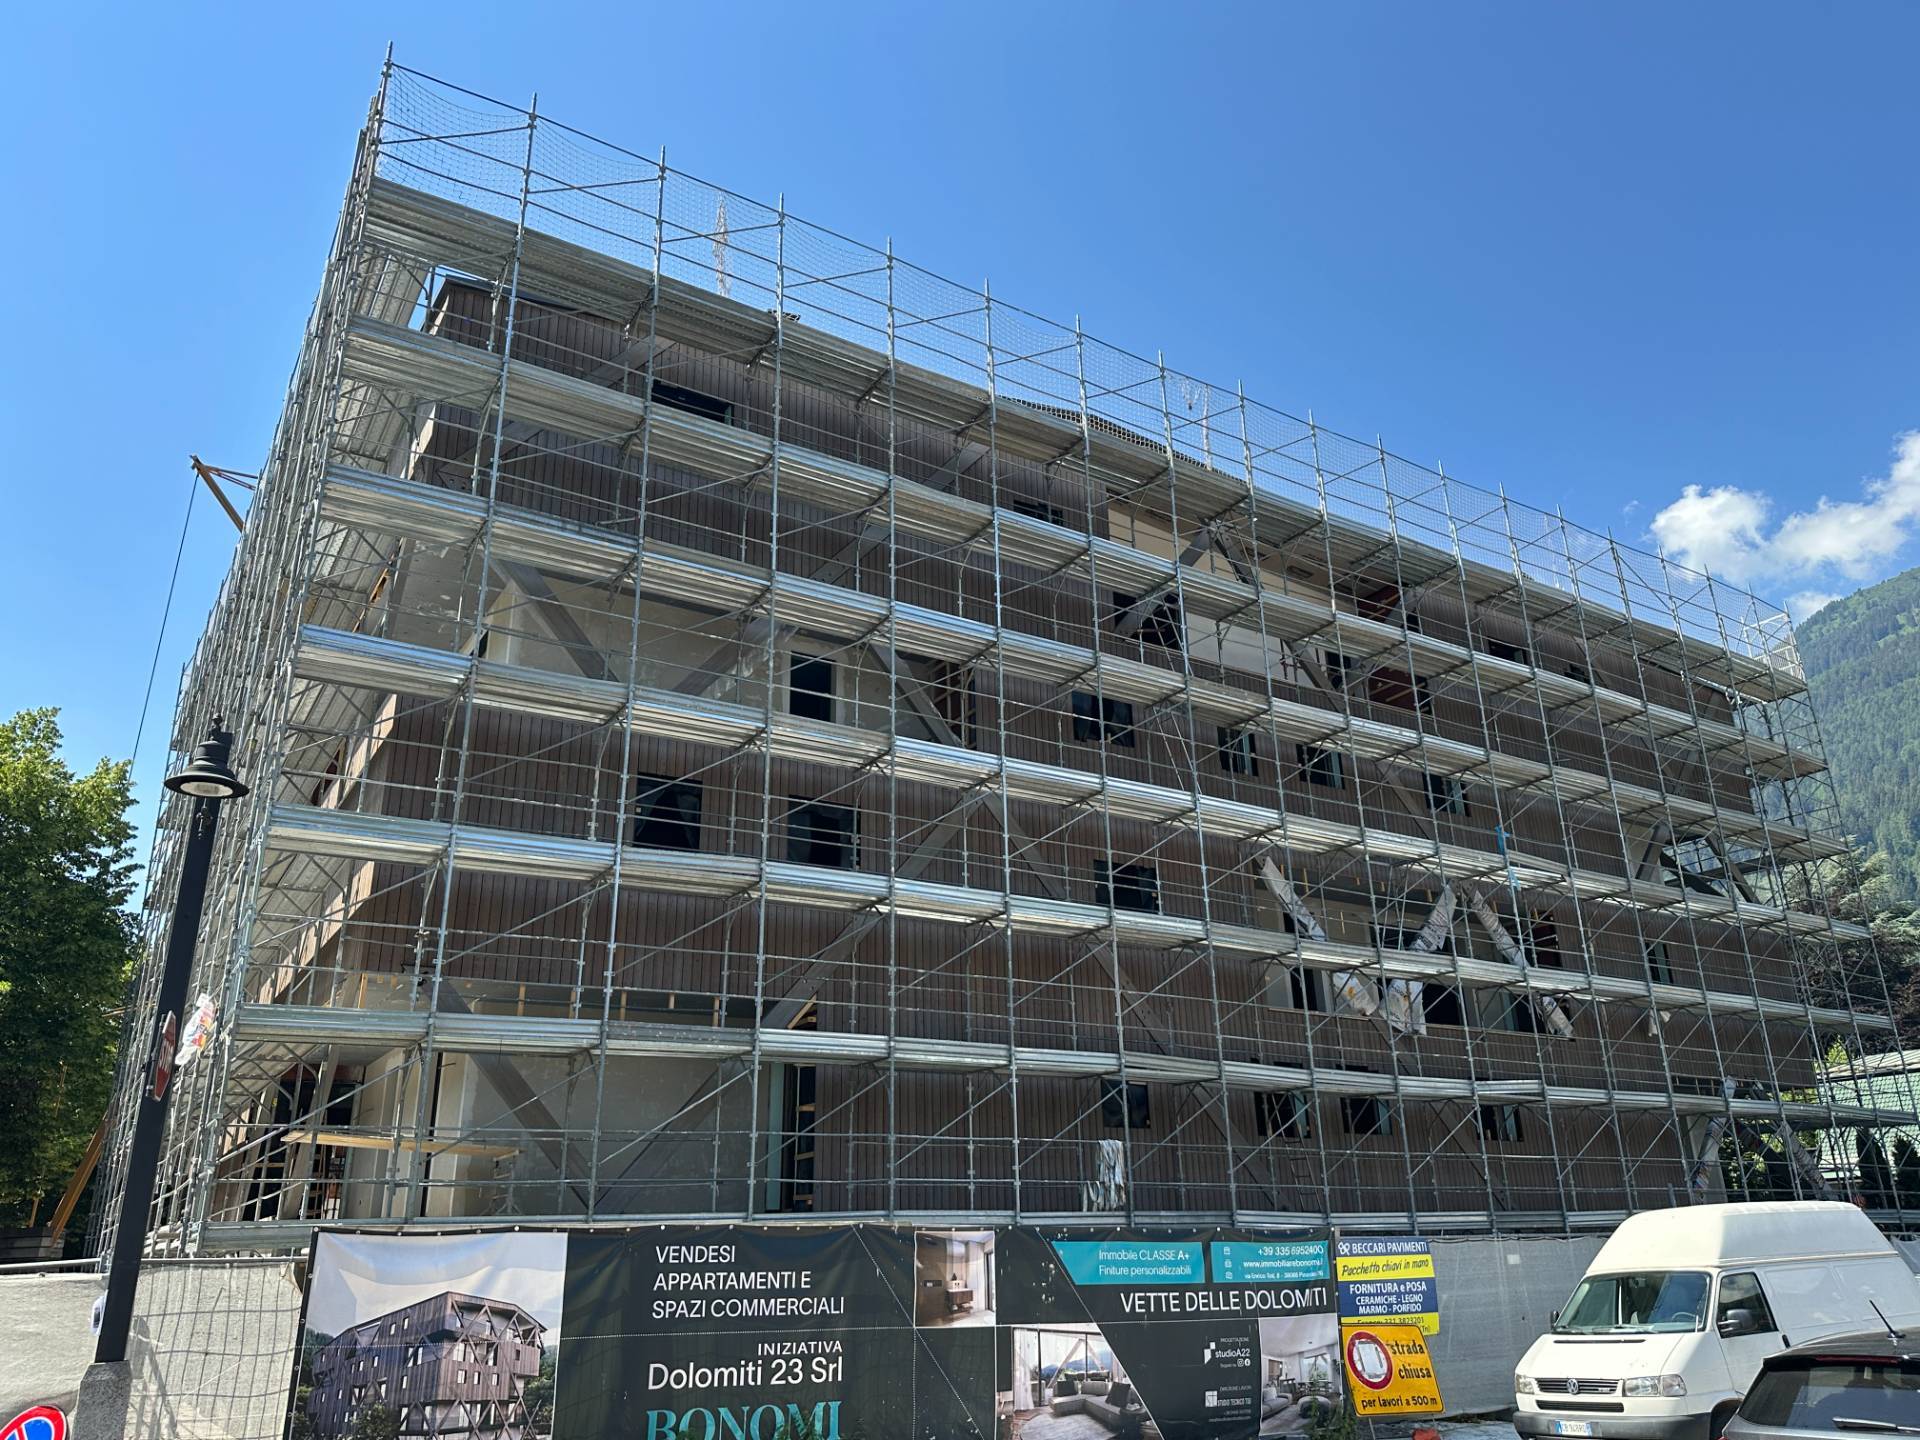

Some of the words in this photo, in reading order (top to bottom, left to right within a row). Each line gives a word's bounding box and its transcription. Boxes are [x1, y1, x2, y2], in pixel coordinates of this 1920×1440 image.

[655, 1245, 736, 1264] VENDESI
[1098, 1249, 1138, 1261] Immobile
[1139, 1249, 1176, 1260] CLASSE
[1177, 1250, 1191, 1260] A+
[1352, 1242, 1385, 1254] BECCARI
[1387, 1241, 1428, 1253] PAVIMENTI
[1098, 1265, 1129, 1276] Finiture
[1131, 1264, 1192, 1276] personalizzabili
[1342, 1262, 1380, 1276] Pacchetto
[1382, 1260, 1403, 1272] chiavi
[1404, 1259, 1410, 1269] in
[1412, 1258, 1429, 1269] mano
[653, 1272, 796, 1291] APPARTAMENTI
[800, 1271, 811, 1289] E
[1350, 1283, 1399, 1294] FORNITURA
[1406, 1281, 1427, 1292] POSA
[1121, 1293, 1180, 1313] VETTE
[1186, 1291, 1240, 1312] DELLE
[1246, 1287, 1327, 1310] DOLOMITI
[1356, 1295, 1397, 1305] CERAMICHE
[1402, 1293, 1423, 1303] LEGNO
[652, 1300, 706, 1319] SPAZI
[711, 1297, 844, 1317] COMMERCIALI
[1359, 1305, 1387, 1314] MARMO
[1393, 1303, 1422, 1313] PORFIDO
[758, 1341, 843, 1356] INIZIATIVA
[1215, 1347, 1250, 1358] studioA22
[1391, 1340, 1425, 1355] strada
[648, 1360, 763, 1390] Dolomiti
[770, 1358, 804, 1385] 23
[811, 1356, 843, 1384] Srl
[1398, 1364, 1432, 1379] chiusa
[1361, 1399, 1376, 1409] per
[1378, 1395, 1404, 1407] lavori
[1412, 1395, 1429, 1406] 500
[646, 1400, 843, 1440] BONOMI
